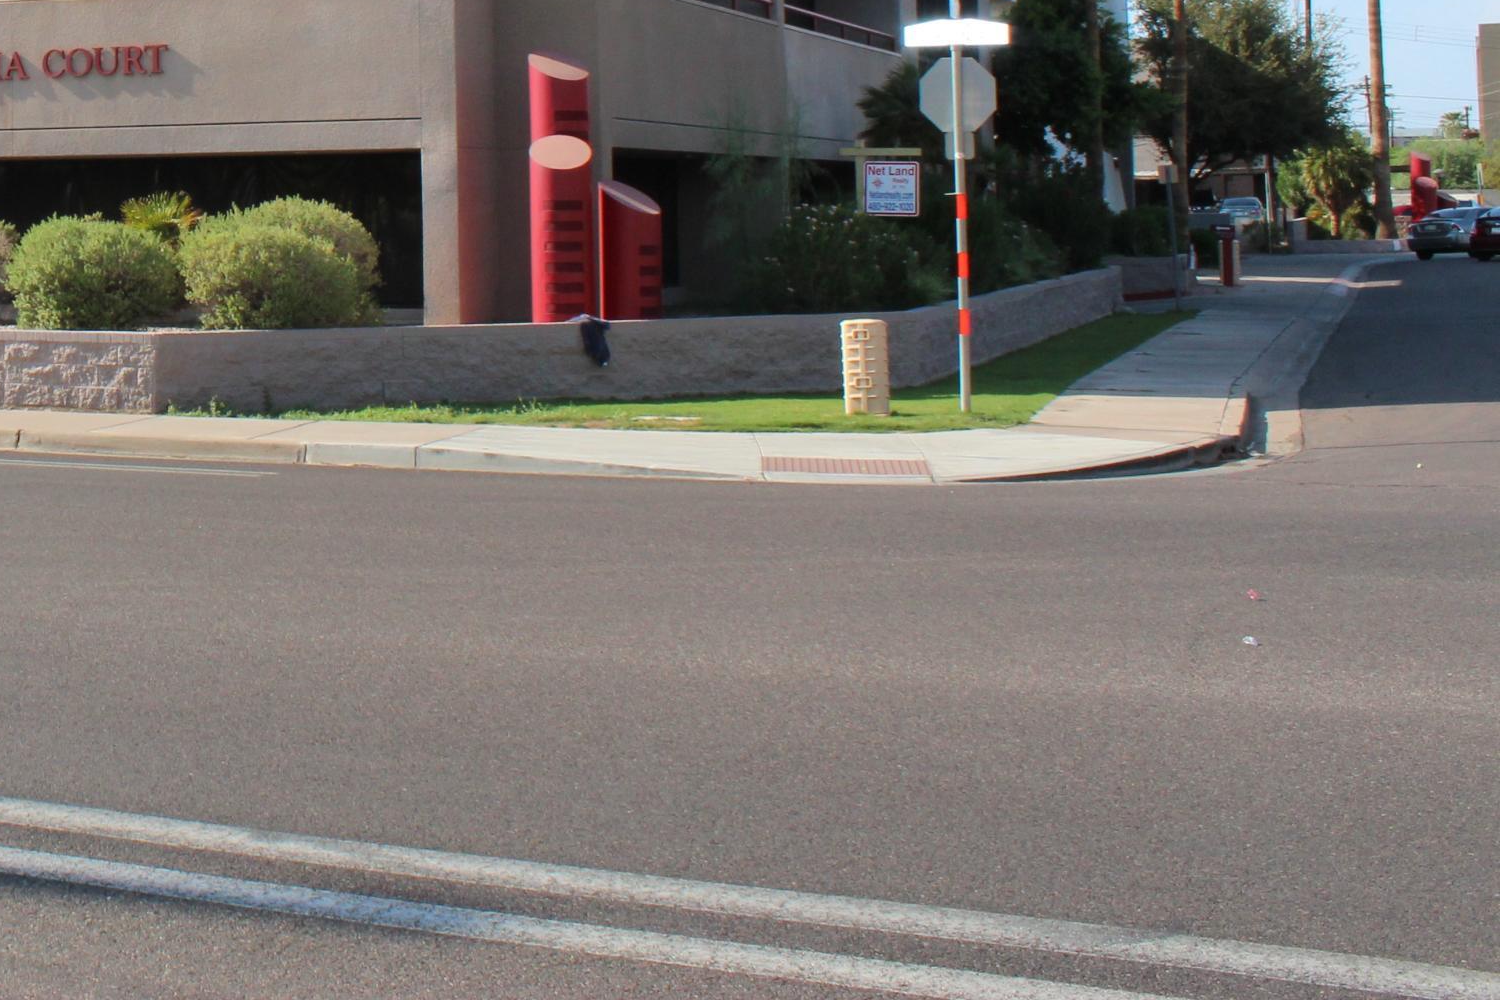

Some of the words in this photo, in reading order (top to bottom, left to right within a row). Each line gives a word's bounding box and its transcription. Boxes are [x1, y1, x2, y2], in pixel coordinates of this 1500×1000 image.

[41, 44, 169, 79] COURT
[868, 166, 885, 176] Net
[889, 166, 915, 176] Land
